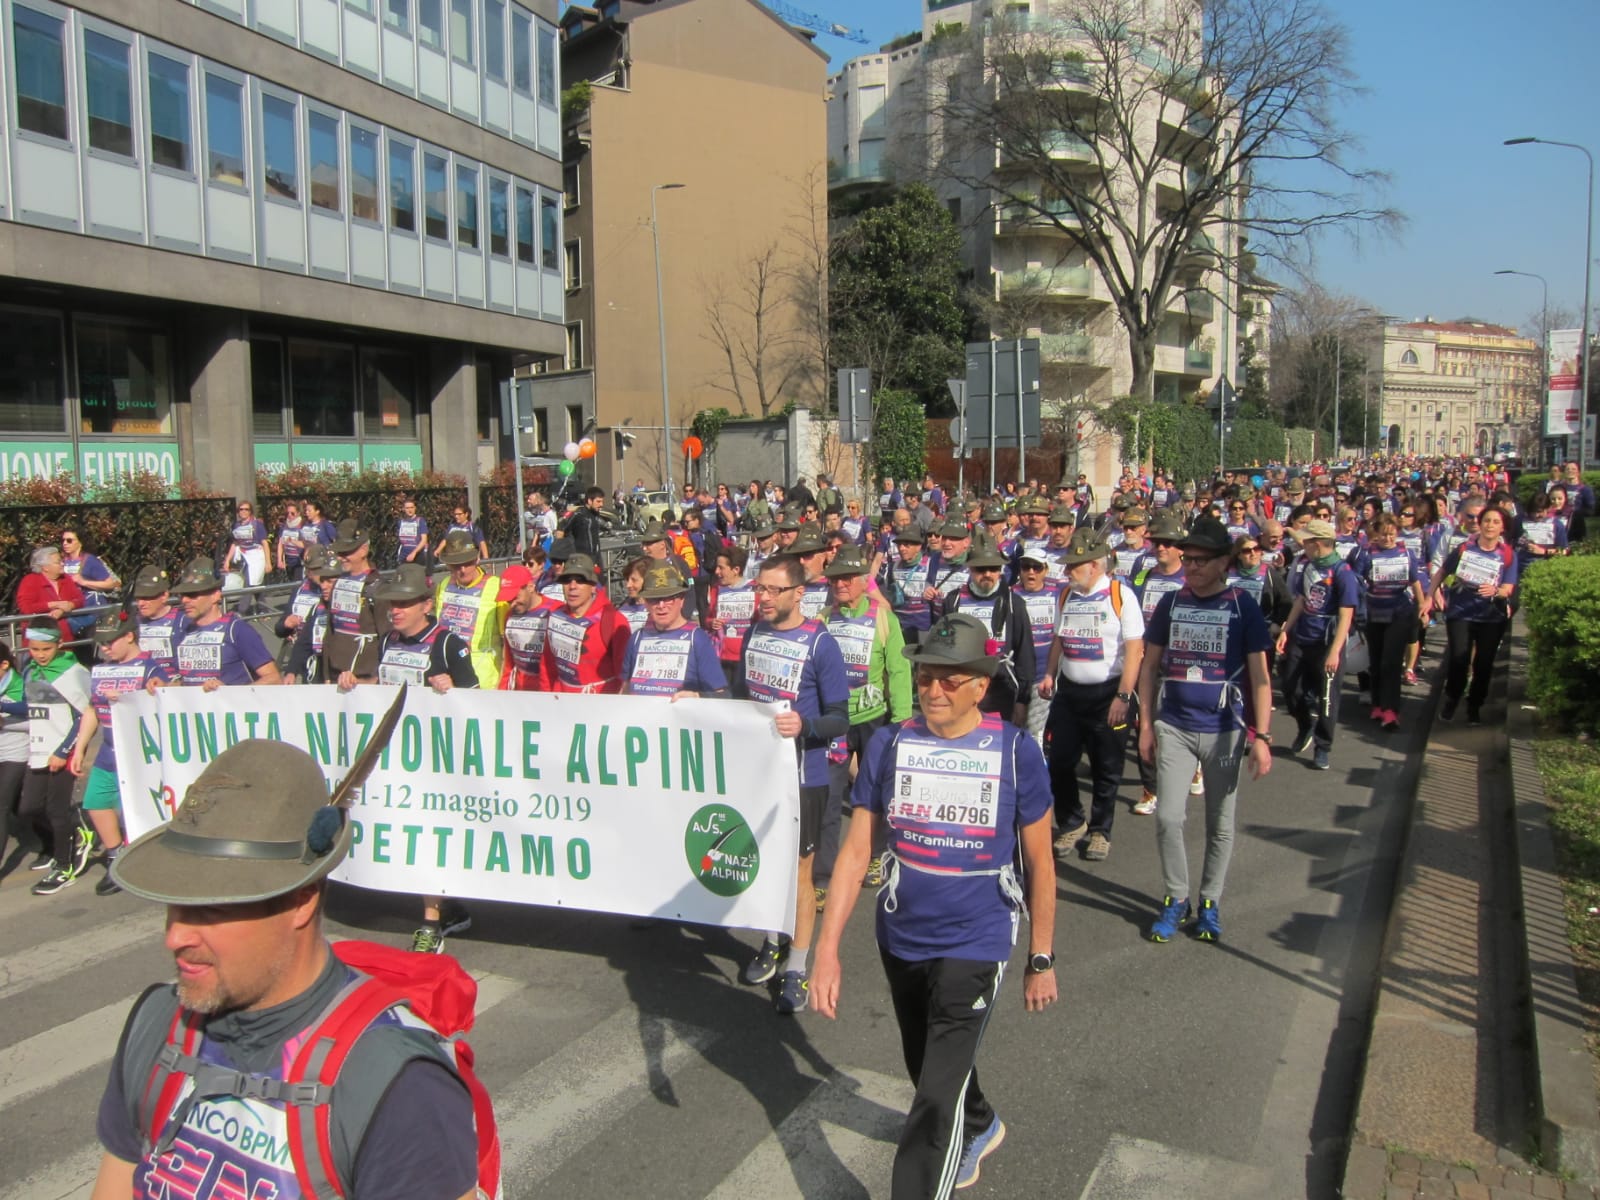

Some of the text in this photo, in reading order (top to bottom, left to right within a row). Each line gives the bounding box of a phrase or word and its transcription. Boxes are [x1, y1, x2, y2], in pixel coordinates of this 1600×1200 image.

[139, 711, 282, 764] AUNATA
[566, 723, 726, 795] ALPINI
[907, 754, 988, 773] BANCO BPM
[423, 789, 518, 823] maggio
[528, 793, 592, 822] 2019
[936, 803, 990, 825] 46796
[903, 829, 984, 850] Stramilano
[711, 866, 748, 882] ALPINI
[241, 1125, 289, 1166] BPM
